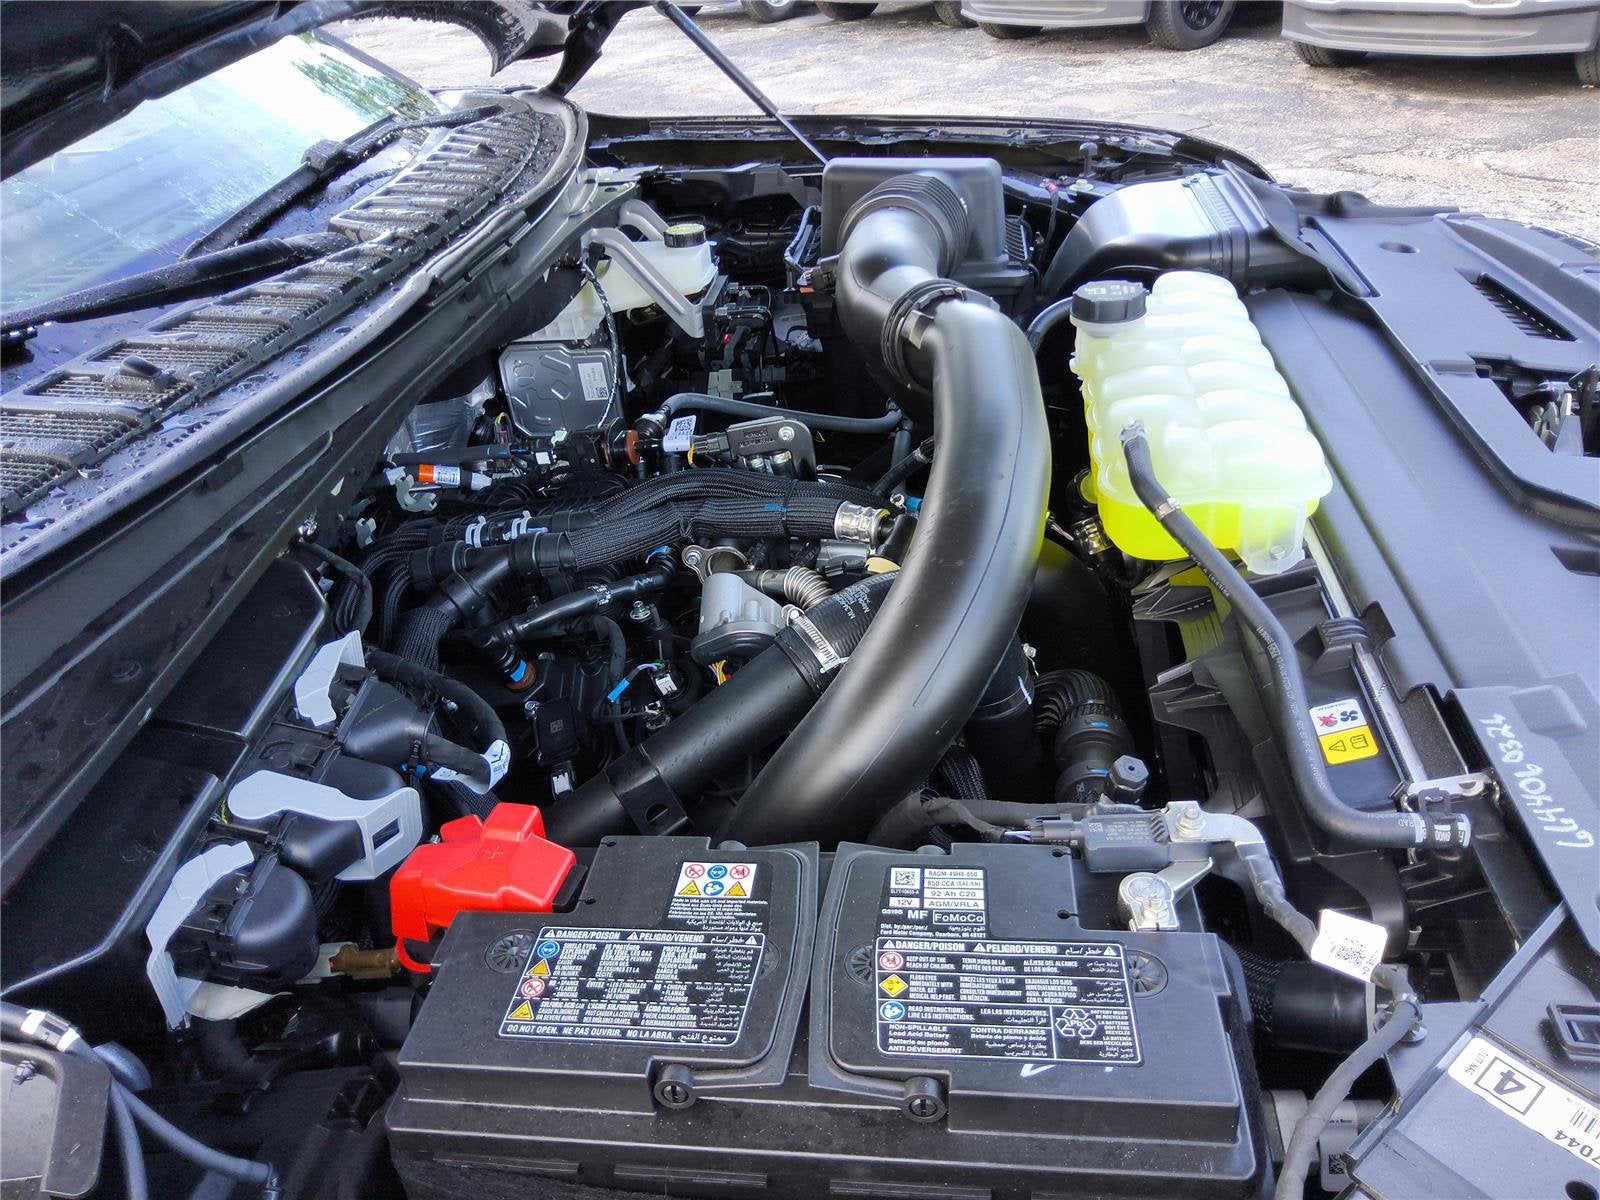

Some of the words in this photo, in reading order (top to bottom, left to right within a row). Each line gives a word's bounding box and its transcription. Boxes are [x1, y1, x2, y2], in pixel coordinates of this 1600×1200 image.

[907, 910, 928, 920] MF
[934, 914, 984, 922] FoMoCo
[556, 929, 620, 940] DANGER/POISON
[638, 932, 704, 943] PELIGRO/VENENO
[896, 940, 965, 952] DANGER/POISON
[986, 944, 1058, 954] PELIGRO/VENENO
[538, 1026, 558, 1034] OPEN.
[590, 1028, 622, 1037] OUVRIR.
[651, 1031, 674, 1040] ABRA.
[889, 1024, 948, 1032] NON-SPILLABLE
[1004, 1028, 1046, 1036] DERRAMES
[924, 1032, 950, 1040] Battery
[906, 1046, 963, 1054] DÉVERSEMENT
[1493, 1070, 1527, 1095] 4
